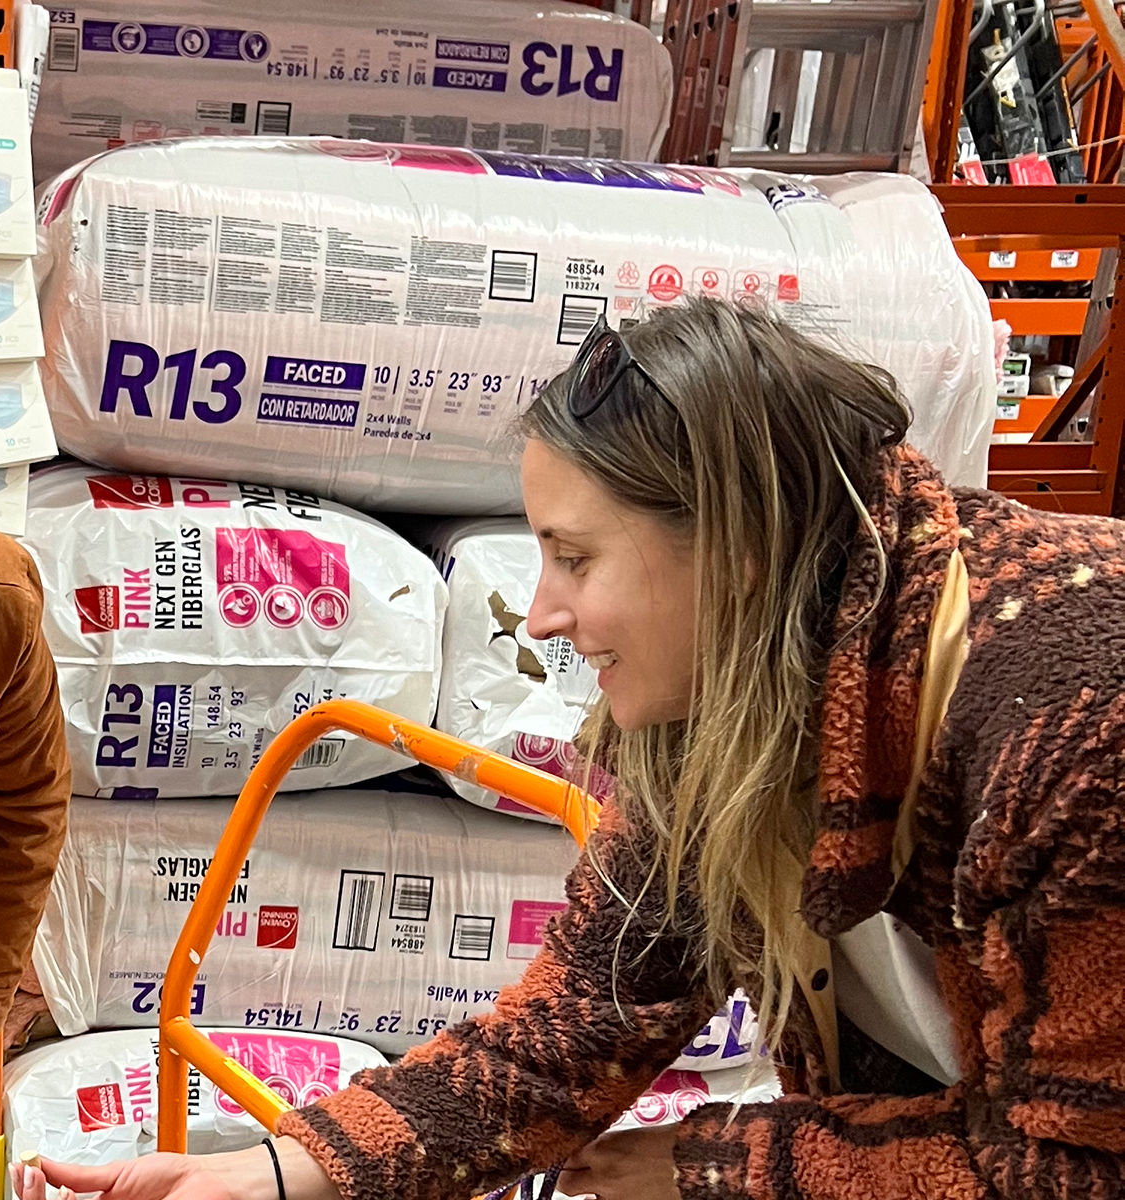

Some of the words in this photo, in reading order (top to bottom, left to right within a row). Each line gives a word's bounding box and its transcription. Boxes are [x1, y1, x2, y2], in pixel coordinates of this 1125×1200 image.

[437, 42, 487, 60] RETARDADOR
[489, 48, 509, 62] CON
[267, 62, 309, 77] 148.54
[520, 40, 625, 103] R13
[413, 73, 426, 86] 10
[446, 71, 494, 88] FACED
[566, 263, 605, 276] 488544
[565, 280, 600, 292] 1183274
[99, 339, 247, 424] R13
[283, 362, 347, 385] FACED
[374, 366, 391, 385] 10
[261, 396, 285, 415] CON
[285, 398, 356, 424] RETARDADOR
[366, 413, 385, 423] 2x4
[387, 415, 412, 426] Walls
[5, 437, 16, 447] 10
[363, 427, 397, 440] Paredes
[401, 430, 413, 440] de
[156, 540, 175, 576] GEN
[182, 526, 202, 629] FIBERGLAS
[124, 567, 152, 629] PINK
[155, 583, 175, 629] NEXT
[207, 685, 222, 728] 148.54
[96, 684, 144, 768] R13
[152, 701, 172, 755] FACED
[172, 685, 192, 768] INSULATION
[253, 728, 264, 751] Walls
[202, 757, 214, 769] 10
[168, 882, 200, 902] GEN
[261, 911, 297, 920] CORNING
[261, 919, 291, 928] OWENS
[395, 924, 426, 934] 1183274
[391, 938, 425, 950] 488544
[109, 971, 141, 980] NUMBER
[427, 985, 472, 1003] Walls
[125, 1062, 152, 1123] PINK
[99, 1087, 110, 1119] OWENS
[106, 1085, 119, 1124] CORNING
